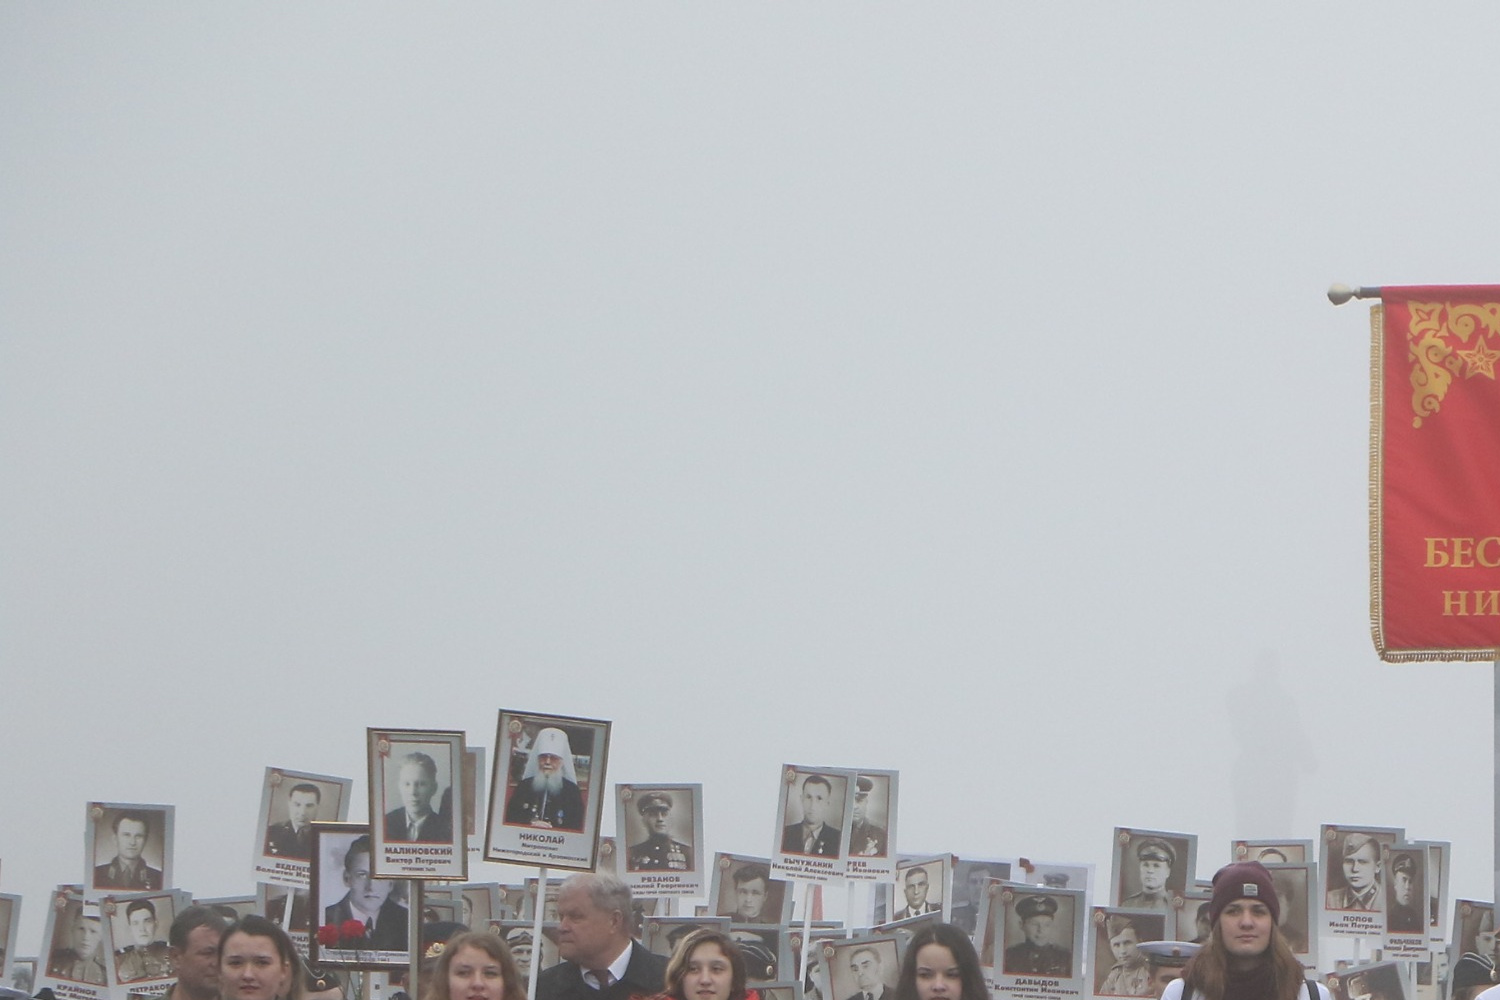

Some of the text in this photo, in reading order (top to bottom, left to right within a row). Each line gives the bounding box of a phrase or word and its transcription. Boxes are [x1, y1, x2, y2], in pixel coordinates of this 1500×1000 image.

[519, 832, 565, 845] НИКОЛАЙ
[384, 845, 453, 856] МАЛИНОВСКИЙ
[385, 856, 452, 866] Виктор Петрович
[641, 875, 681, 883] РЯЗАНОВ
[1342, 915, 1373, 923] ПОПОВ
[1350, 922, 1383, 930] Петрови
[1014, 978, 1060, 987] ДАВЫДОВ
[994, 984, 1039, 993] Константин
